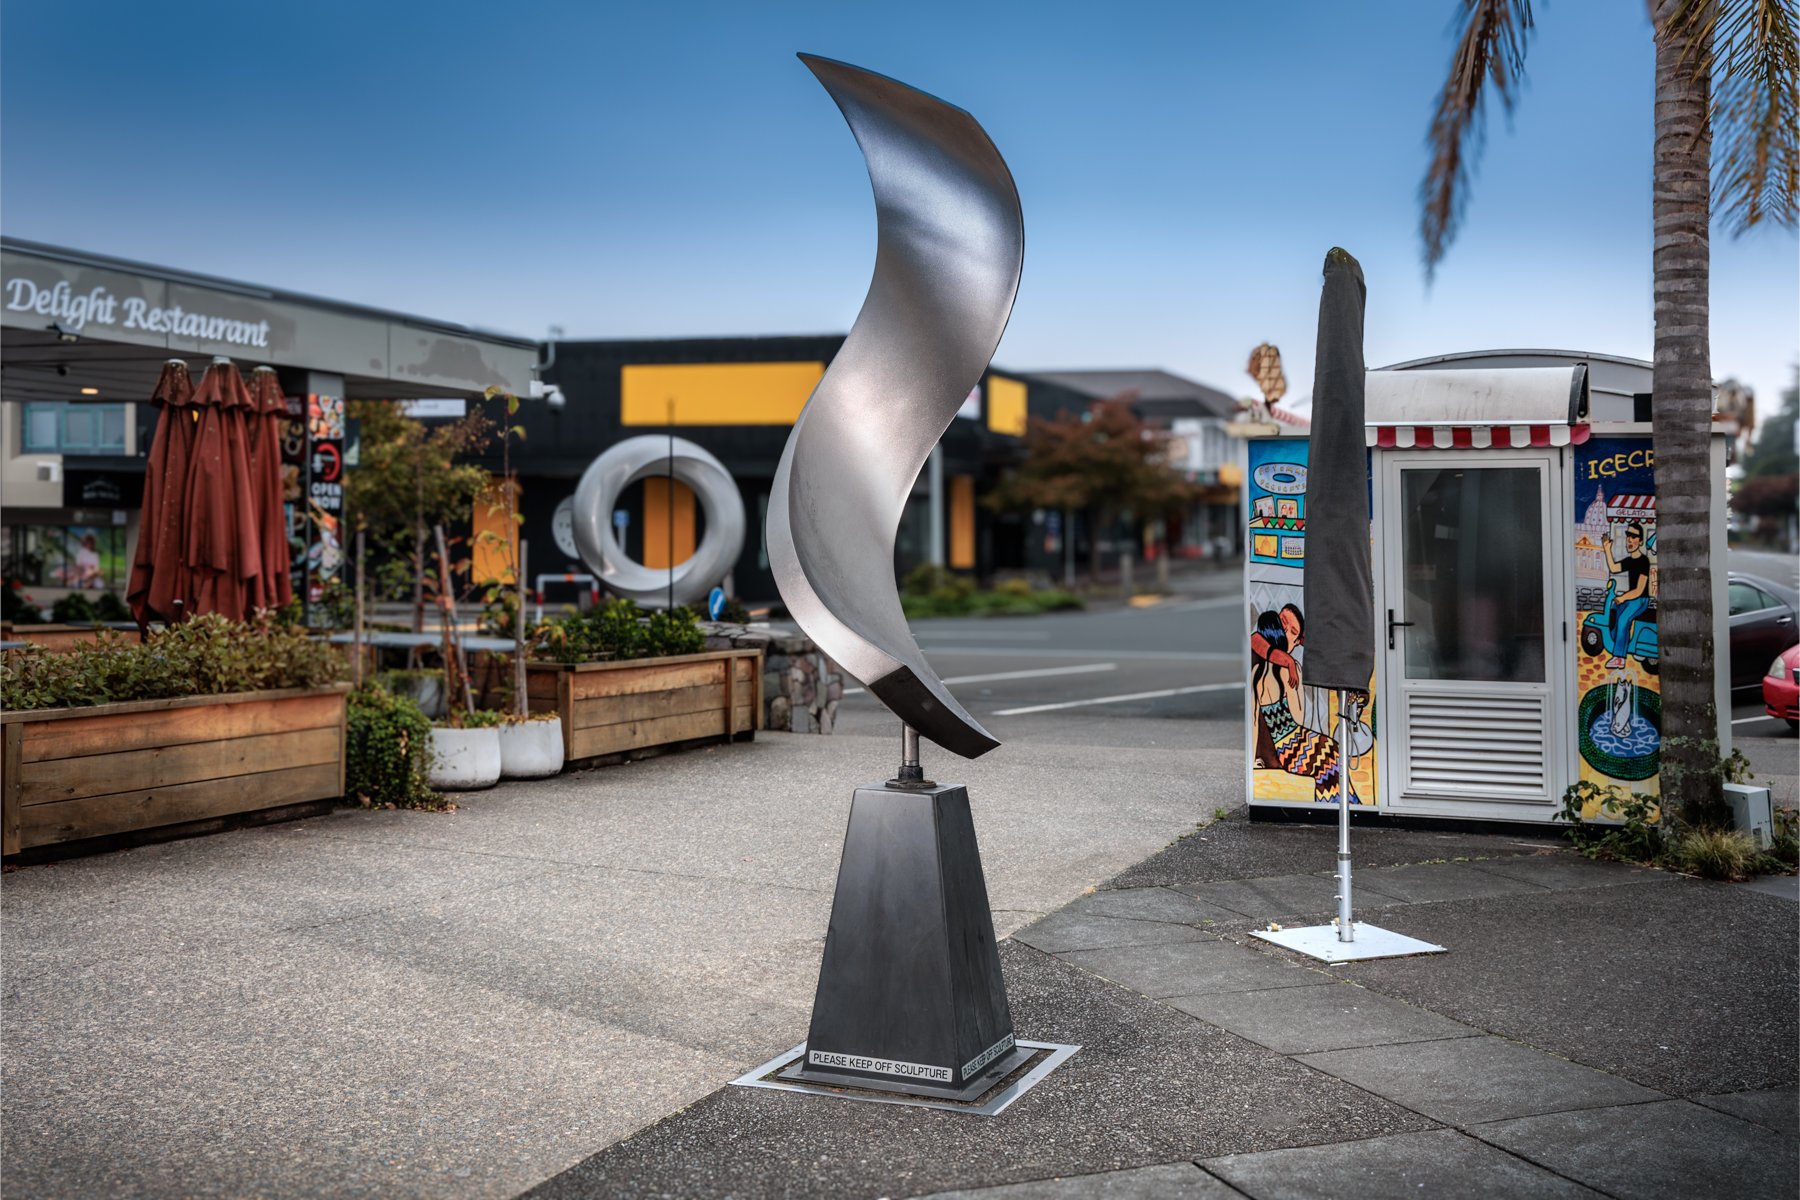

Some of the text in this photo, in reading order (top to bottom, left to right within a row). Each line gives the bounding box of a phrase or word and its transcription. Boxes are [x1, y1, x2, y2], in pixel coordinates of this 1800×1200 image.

[5, 278, 270, 347] Delight Restaurant
[311, 482, 341, 496] OPEN
[1616, 508, 1646, 517] GELATO
[813, 1053, 948, 1080] PLEASE KEEP OFF SCULPTURE
